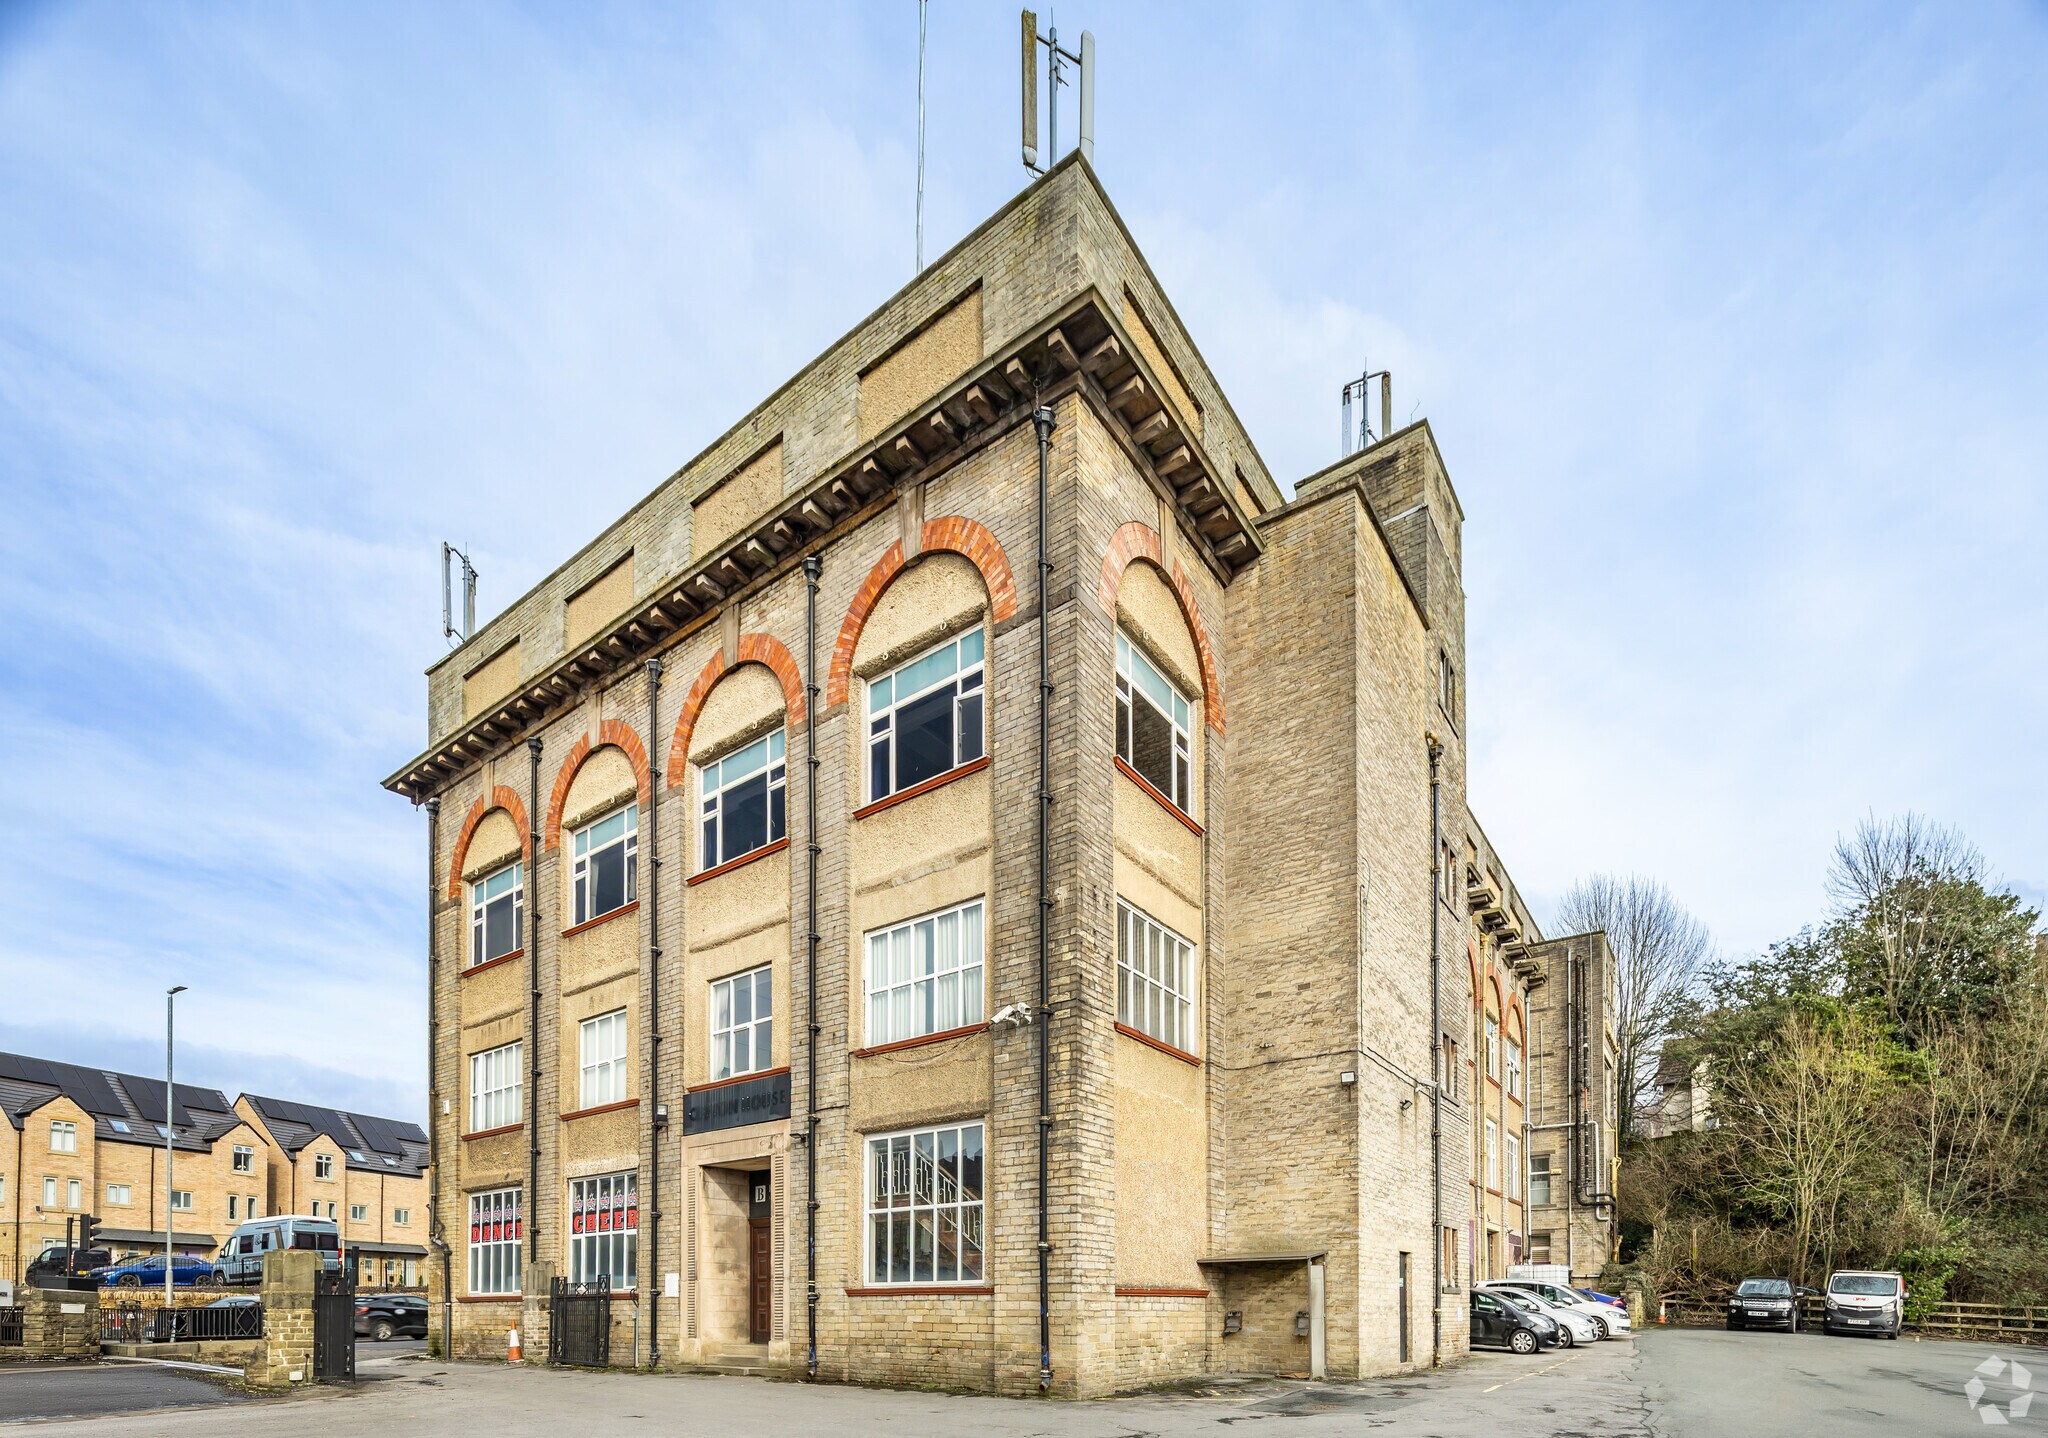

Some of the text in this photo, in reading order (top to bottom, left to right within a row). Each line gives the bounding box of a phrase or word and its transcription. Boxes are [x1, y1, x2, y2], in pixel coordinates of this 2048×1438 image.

[741, 1090, 786, 1111] HOUSE
[757, 1187, 764, 1200] B
[573, 1209, 638, 1233] CHEER
[471, 1222, 522, 1242] DANCE
